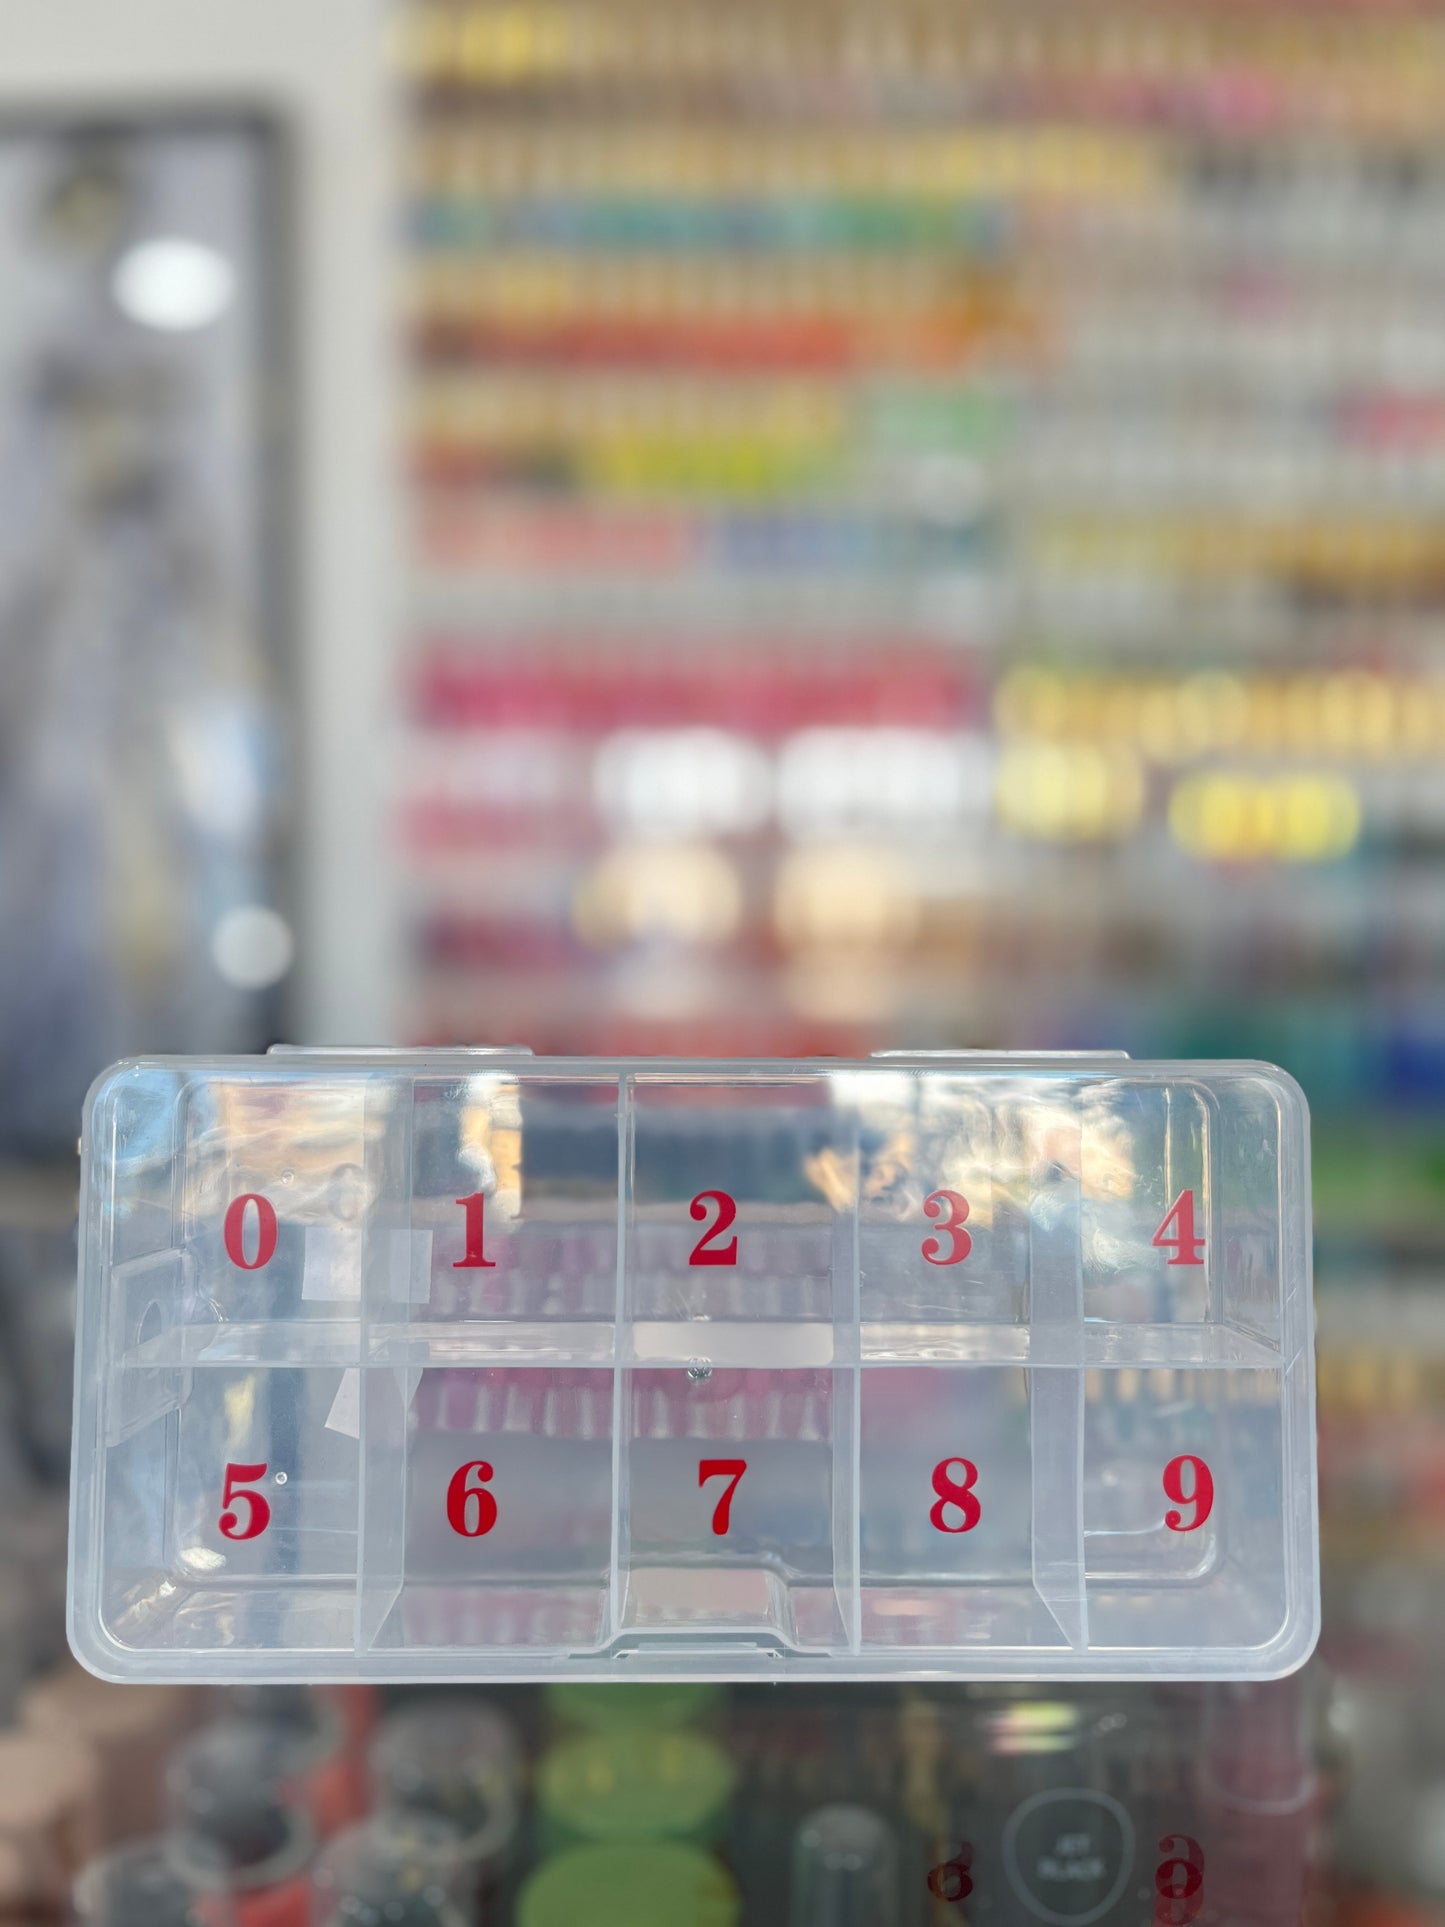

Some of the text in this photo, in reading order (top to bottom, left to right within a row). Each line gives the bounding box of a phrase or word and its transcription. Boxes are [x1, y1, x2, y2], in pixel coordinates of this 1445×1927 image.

[223, 1188, 1206, 1269] 0 1 2 3 4
[217, 1454, 1215, 1541] 5 6 7 8 9
